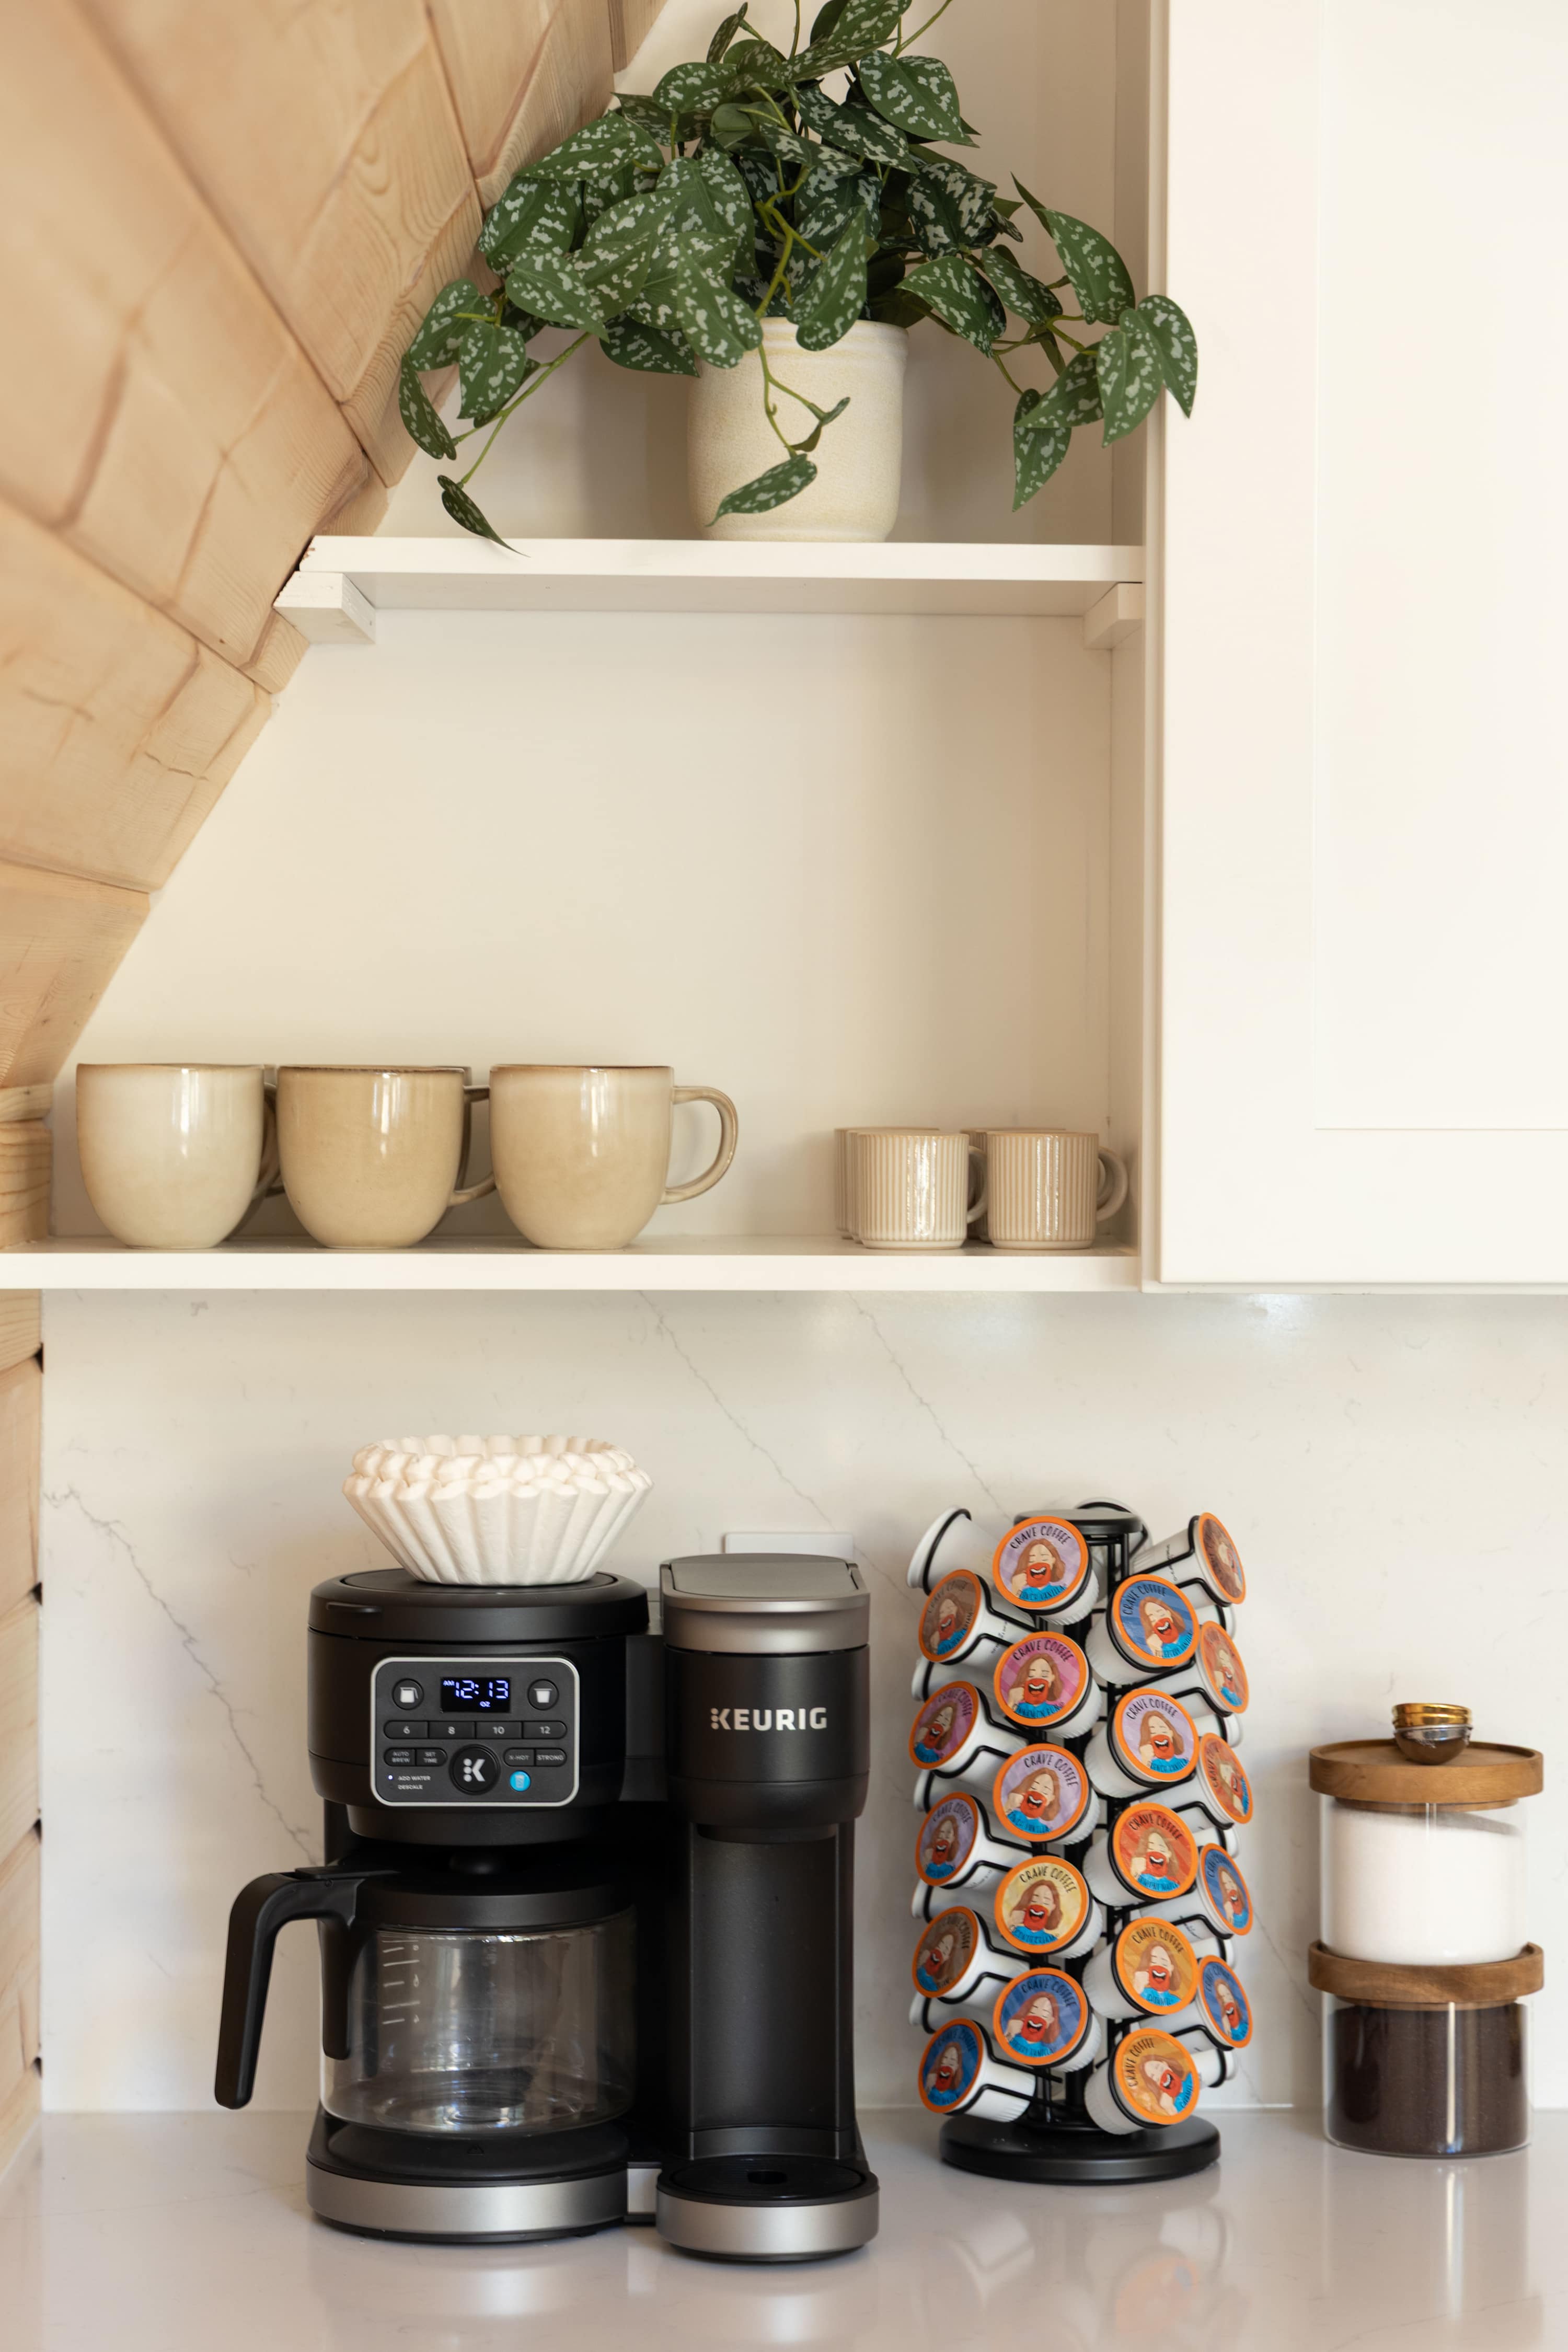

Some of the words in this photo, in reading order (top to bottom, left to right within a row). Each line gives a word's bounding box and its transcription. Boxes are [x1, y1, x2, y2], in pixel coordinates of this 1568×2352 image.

[1010, 1527, 1036, 1549] CRAVE
[1041, 1526, 1071, 1544] COFFEE
[1122, 1590, 1140, 1615] CRAVE
[1137, 1584, 1167, 1597] COFFEE
[1013, 1641, 1041, 1661] CRAVE
[1044, 1640, 1074, 1662] COFFEE
[455, 1680, 509, 1699] 12:13
[957, 1691, 973, 1716] COFFEE
[1126, 1698, 1148, 1720] CRAVE
[1150, 1699, 1178, 1717] COFFEE
[403, 1726, 410, 1734] 6
[448, 1726, 455, 1734] 8
[710, 1707, 827, 1731] KEURIG
[1024, 1754, 1053, 1768] CRAVE
[1054, 1759, 1079, 1786] COFFEE
[1128, 1814, 1154, 1830] CRAVE
[1156, 1815, 1183, 1839] COFFEE
[1020, 1866, 1048, 1883] CRAVE
[1051, 1868, 1077, 1893] COFFEE
[1132, 1927, 1157, 1944] CRAVE
[1159, 1929, 1185, 1954] COFFEE
[1021, 1978, 1051, 1993] CRAVE
[1053, 1981, 1077, 2007] COFFEE
[1130, 2038, 1155, 2057] COFFEE
[1125, 2057, 1138, 2087] CRAVE
